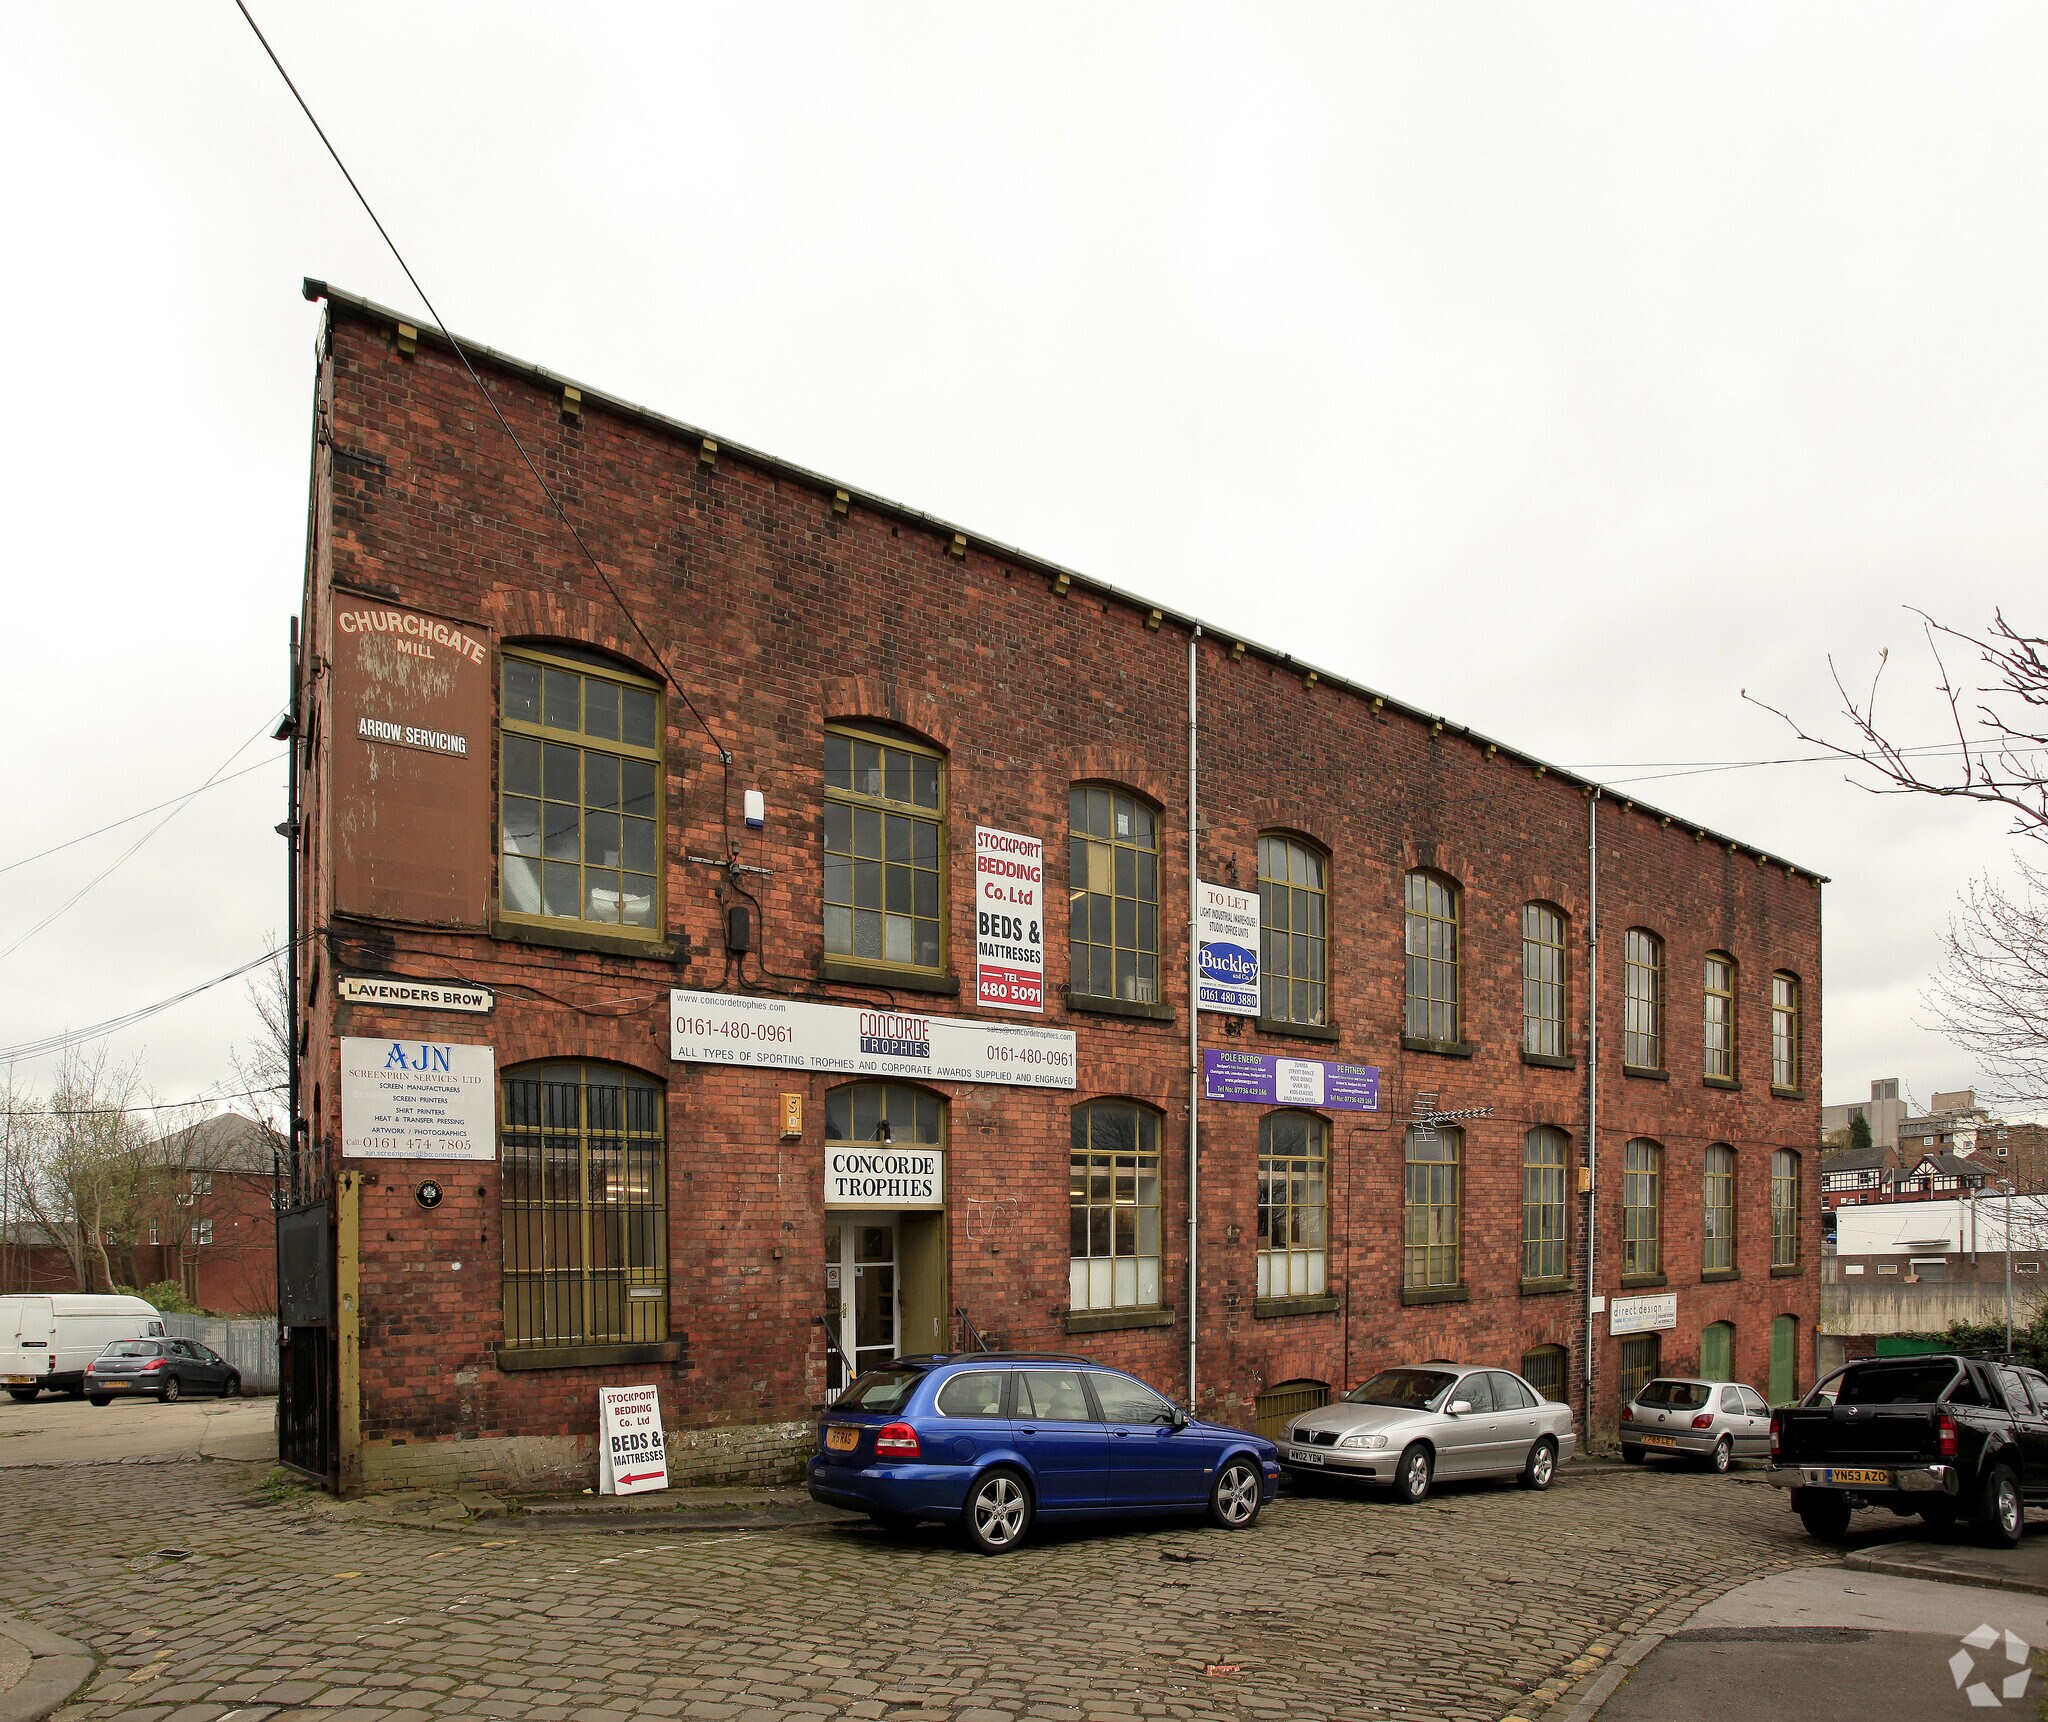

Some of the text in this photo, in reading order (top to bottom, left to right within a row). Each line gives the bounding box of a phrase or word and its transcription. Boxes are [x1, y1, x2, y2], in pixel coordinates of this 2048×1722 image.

[339, 611, 487, 665] CHURCHGATE
[397, 639, 435, 659] MILL
[359, 717, 466, 754] ARROW SERVICING
[977, 831, 1040, 858] STOCKPORT
[977, 856, 1041, 883] BEDDING
[984, 882, 1033, 906] Co. Ltd
[1208, 891, 1249, 910] TO LET
[1200, 906, 1211, 918] LIGHT
[1212, 908, 1233, 922] INDUSTRIAL
[979, 911, 1041, 945] BEDS &
[979, 941, 1041, 964] MATTRESSES
[1200, 949, 1258, 980] Buckley
[1004, 972, 1019, 983] TEL
[348, 983, 483, 1006] LAVENDERS BROW
[676, 993, 786, 1012] www.concordetrophies.com
[981, 982, 1041, 1003] 480 5091
[1201, 988, 1256, 1006] 0161 480 3880
[676, 1016, 793, 1043] 0161-480-0961
[859, 1012, 930, 1041] CONCORDE
[861, 1037, 930, 1057] TROPHIES
[987, 1045, 1074, 1067] 0161-480-0961
[384, 1043, 451, 1072] AJN
[678, 1046, 1073, 1086] ALL TYPES OF SPORTING TROPHIES AND CORPORATE AWARDS SUPPLIED AND ENGRAVED
[1220, 1052, 1262, 1064] POLE ENERGY
[349, 1069, 482, 1084] SCREENPRIN SERVICES LTD
[1337, 1065, 1366, 1076] PE FITNESS
[407, 1084, 460, 1093] MANUFACTURERS
[363, 1137, 397, 1149] 0161
[406, 1138, 431, 1150] 474
[439, 1139, 471, 1150] 7805
[365, 1150, 472, 1159] ajn.screenprint@btconnect.com
[832, 1154, 934, 1175] CONCORDE
[835, 1178, 933, 1197] TROPHIES
[1613, 1301, 1637, 1317] direct
[1638, 1300, 1662, 1322] design
[607, 1391, 655, 1404] STOCKPORT
[614, 1404, 652, 1416] BEDDING
[619, 1416, 650, 1428] Co. Ltd
[611, 1431, 662, 1453] BEDS &
[614, 1449, 664, 1467] MATTRESSES
[1833, 1470, 1886, 1482] YN53 AZO
